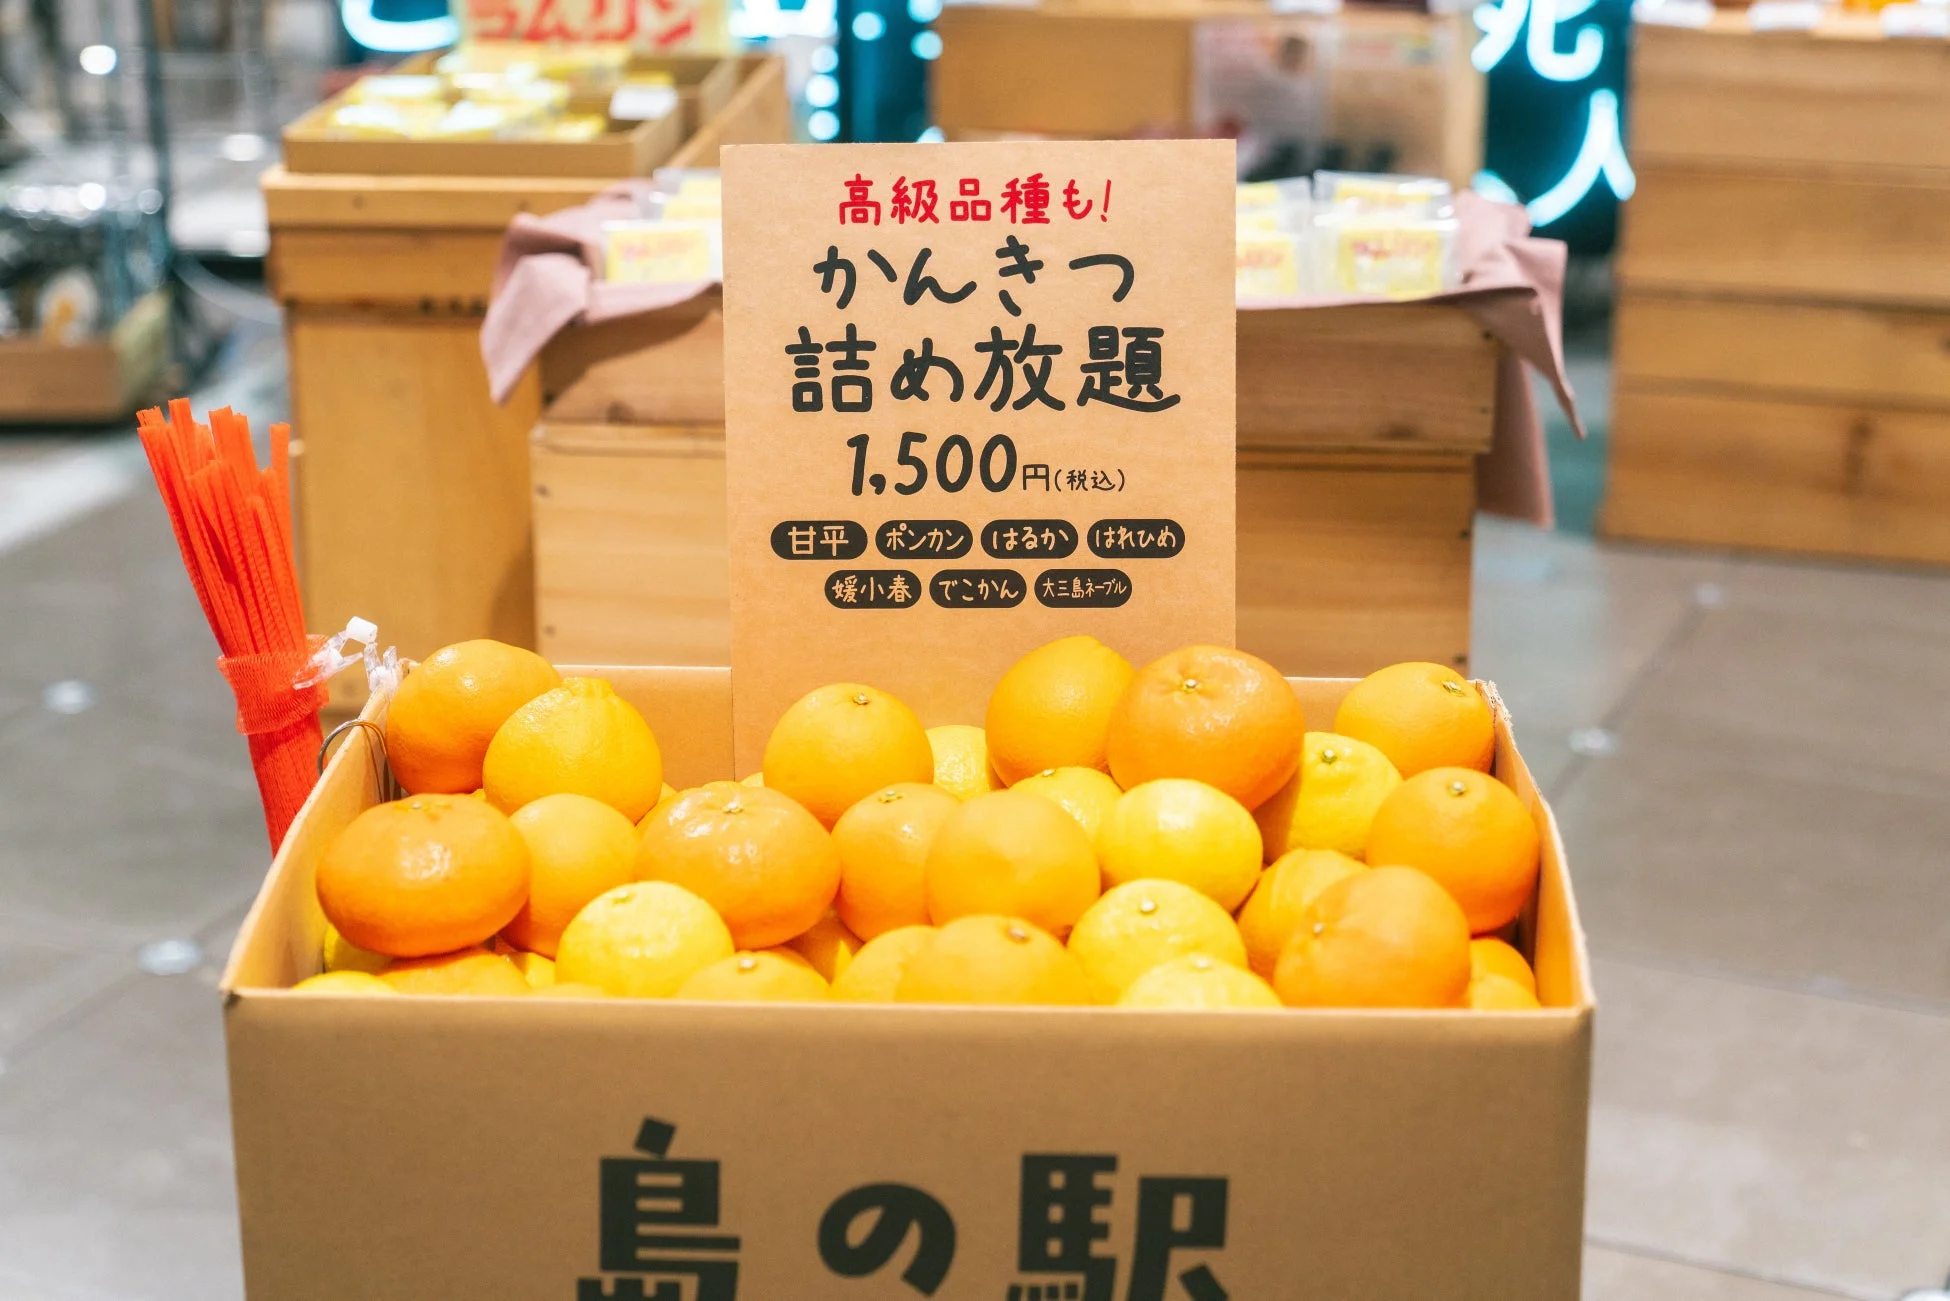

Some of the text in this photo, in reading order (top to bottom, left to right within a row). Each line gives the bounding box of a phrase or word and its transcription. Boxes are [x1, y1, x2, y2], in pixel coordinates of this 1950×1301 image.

[839, 172, 1112, 226] 高級品種も!
[813, 234, 1135, 317] かんきつ
[784, 322, 1181, 413] 詰め放題
[787, 522, 1177, 557] 甘平 ポンカン はるか はれひめ
[831, 574, 1128, 604] 媛小春 でこかん 大三島ネーブル
[576, 1116, 1229, 1301] 島の駅
